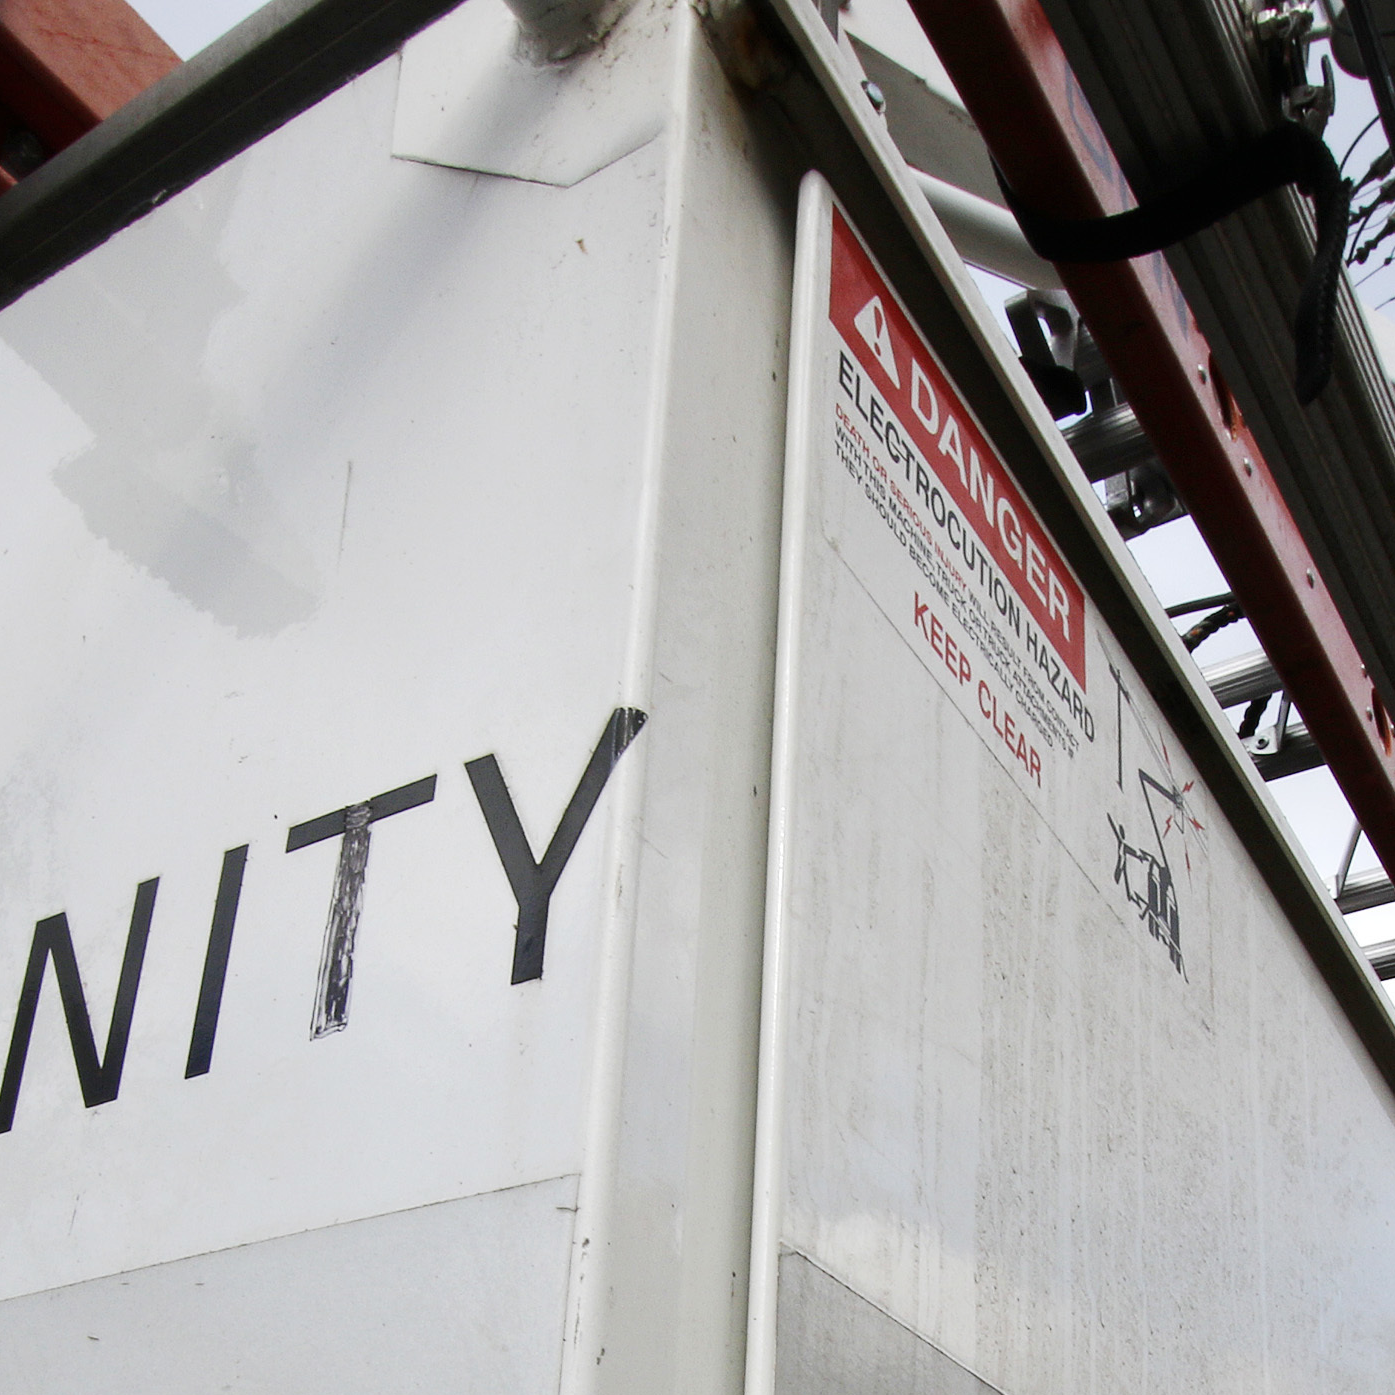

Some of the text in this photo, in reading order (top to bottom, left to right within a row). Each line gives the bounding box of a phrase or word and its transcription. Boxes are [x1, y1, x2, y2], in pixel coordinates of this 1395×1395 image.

[835, 421, 862, 467] WITH
[863, 460, 886, 500] THIS
[936, 562, 967, 613] TRUCK
[835, 440, 862, 485] THEY
[865, 483, 906, 547] SHOULD
[909, 544, 949, 607] BECOME
[952, 602, 1013, 694] ELECTRICALLY
[836, 403, 870, 459] DEATH
[872, 456, 887, 483] OR
[890, 480, 932, 546] SERIOUS
[934, 541, 967, 590] INJURY
[839, 350, 1095, 743] ELECTROCUTION HAZARD
[911, 358, 1071, 642] DANGER
[915, 590, 1042, 789] KEEP CLEAR
